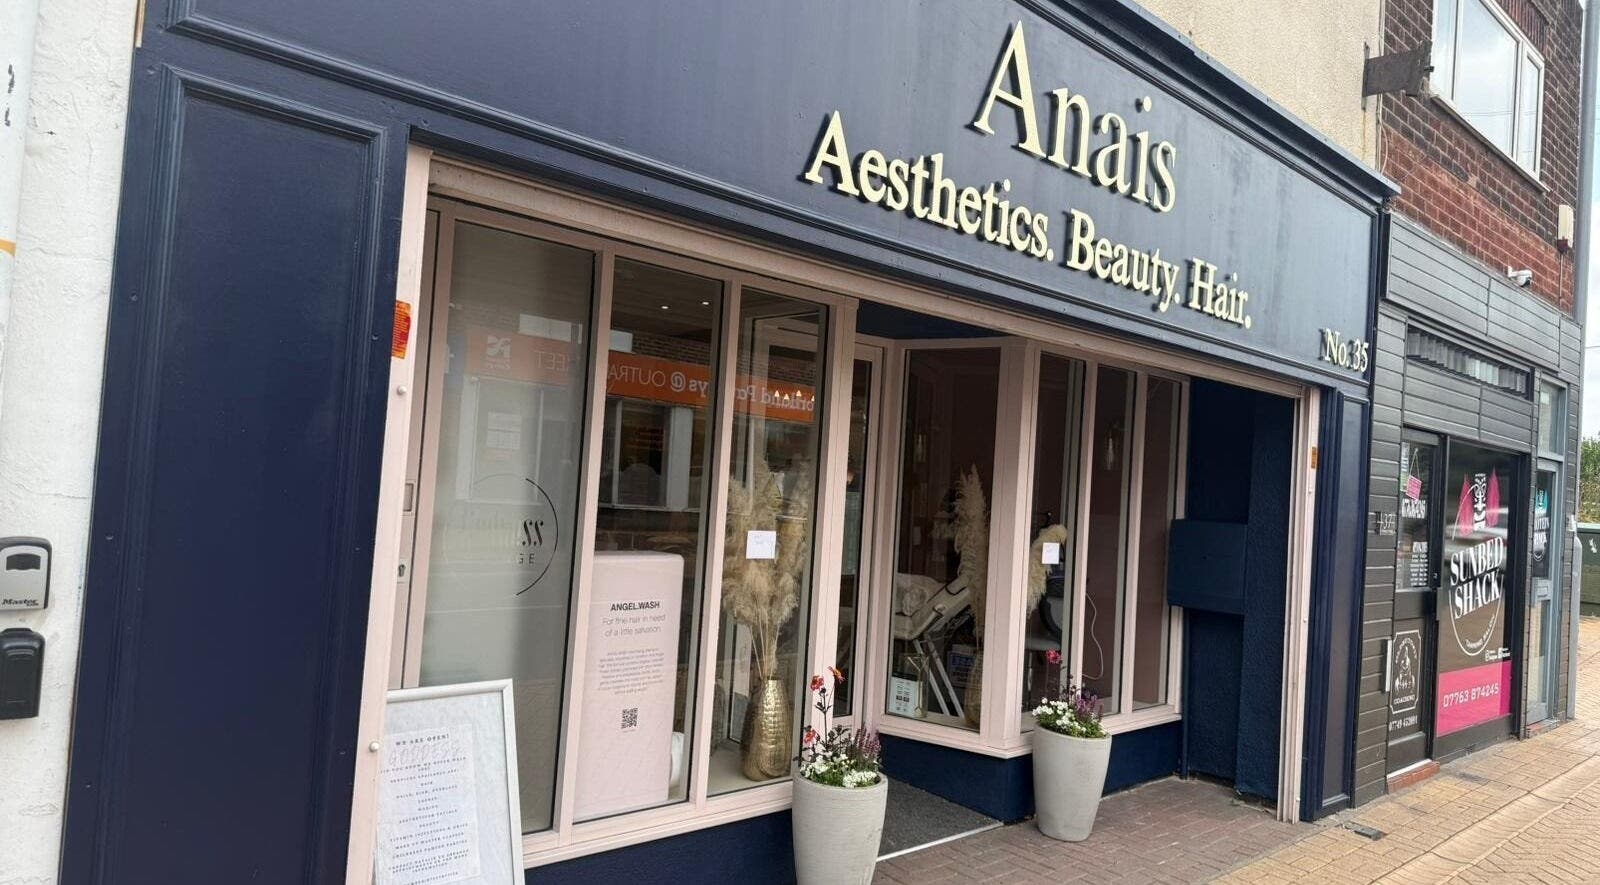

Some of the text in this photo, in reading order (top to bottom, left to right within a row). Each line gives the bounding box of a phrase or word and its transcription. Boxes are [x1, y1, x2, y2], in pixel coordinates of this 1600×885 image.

[973, 19, 1177, 214] Anais
[804, 109, 1252, 330] Aesthetics. Beauty. Hair.
[1450, 536, 1504, 587] SUNBED
[1454, 569, 1501, 619] SHACK
[1442, 681, 1500, 708] 07763 874245
